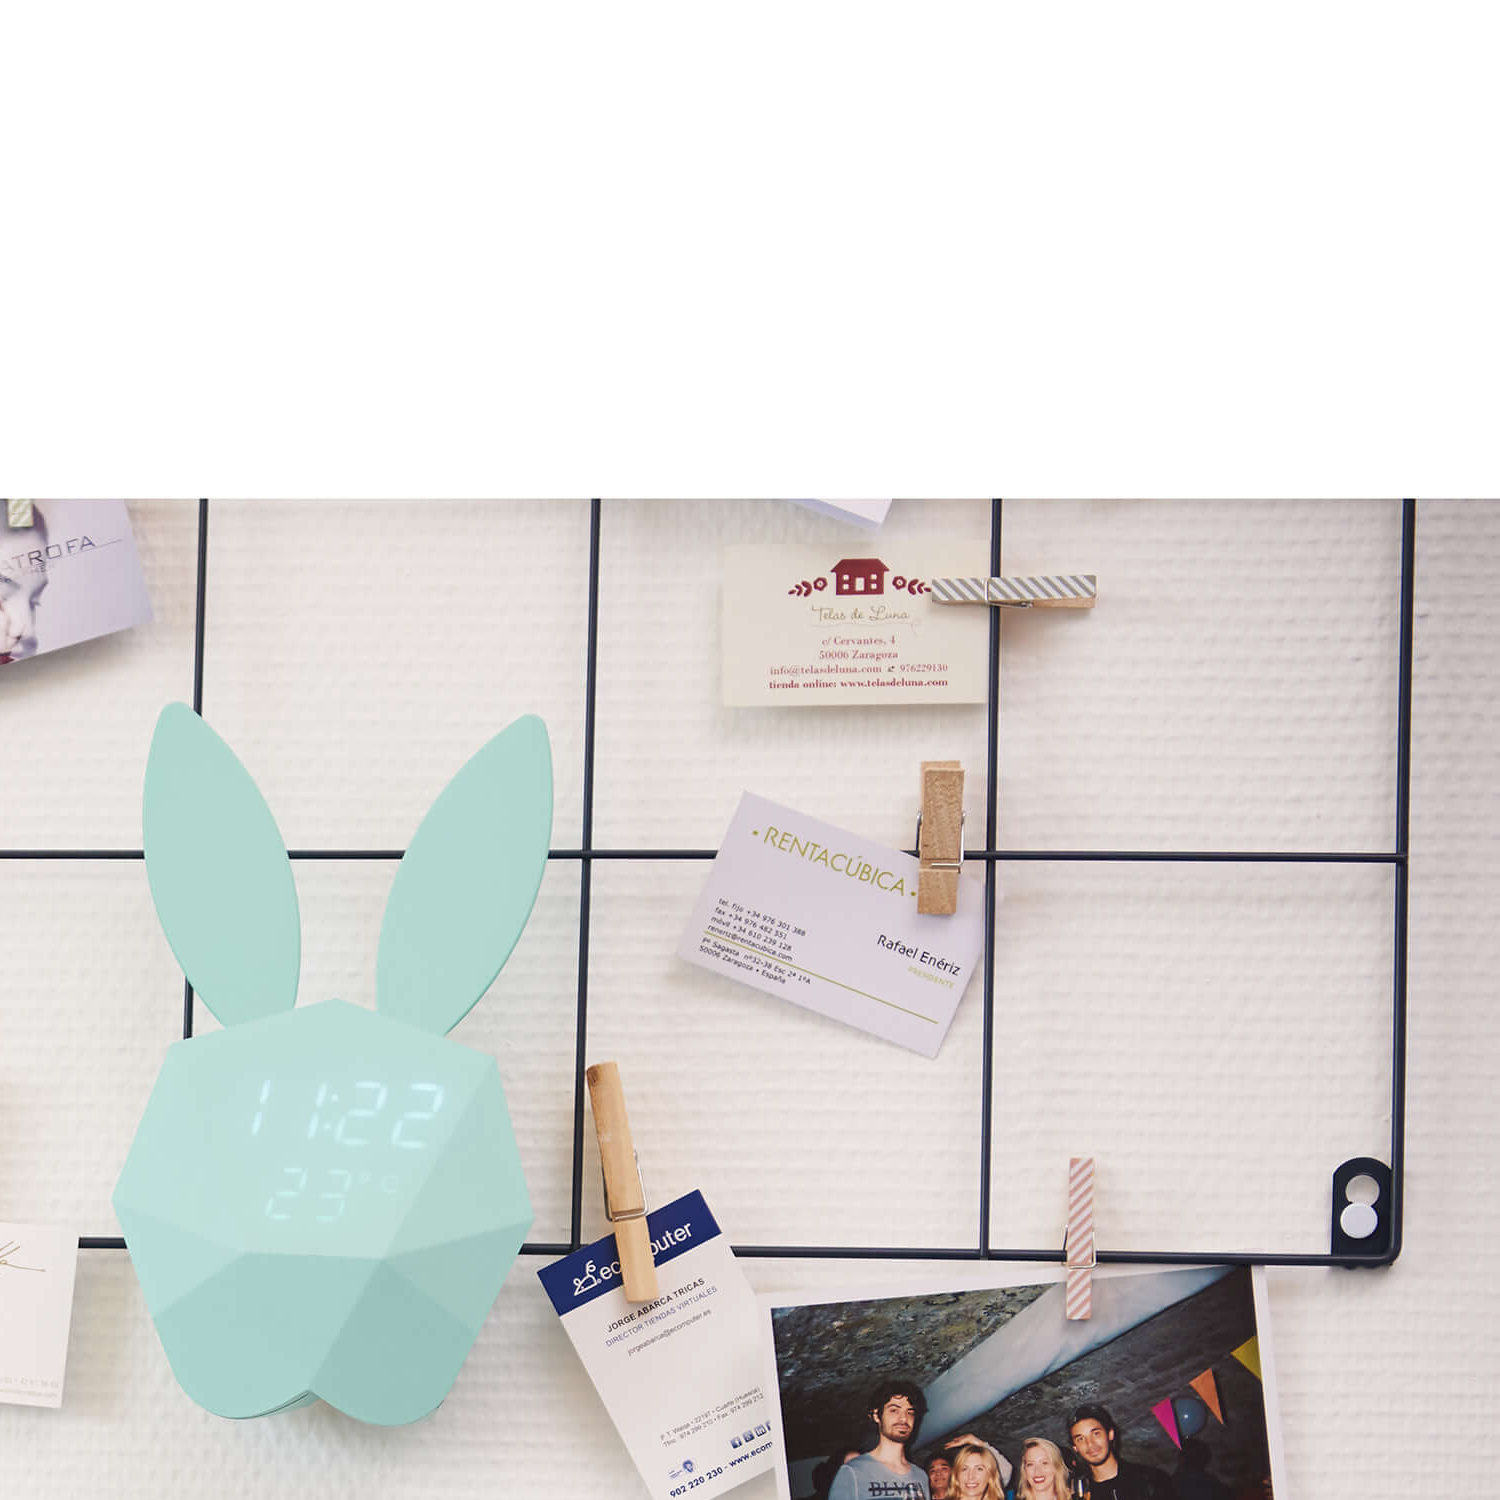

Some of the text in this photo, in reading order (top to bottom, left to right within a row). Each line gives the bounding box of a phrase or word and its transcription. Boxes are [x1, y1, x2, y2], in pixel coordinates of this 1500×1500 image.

[811, 604, 909, 622] Telas de Luna
[819, 650, 898, 662] 50006 Zaragoza
[834, 635, 887, 647] Cervantes,
[890, 635, 896, 645] 4
[768, 678, 949, 689] tienda online: www.telasdeluna.com
[770, 663, 948, 676] info@telasdeluna.com 976229130
[763, 826, 906, 897] RENTACÚBICA
[710, 915, 792, 951] móvil +34 610 239 128
[714, 907, 725, 915] fax
[728, 912, 742, 922] +34
[743, 918, 757, 928] 976
[746, 909, 759, 918] +34
[761, 915, 775, 924] 976
[777, 921, 790, 930] 301
[698, 945, 786, 984] 50006 Zaragoza España
[711, 940, 740, 958] Sagasta
[773, 965, 786, 974] Esc
[877, 934, 961, 976] Rafael Enériz
[252, 1079, 445, 1149] 11:22
[605, 1285, 717, 1346] DIRECTOR TIENDAS VIRTUALES
[606, 1278, 704, 1332] JORGE ABARCA TRICAS
[670, 1485, 686, 1497] 902
[688, 1475, 704, 1488] 220
[706, 1466, 722, 1479] 230
